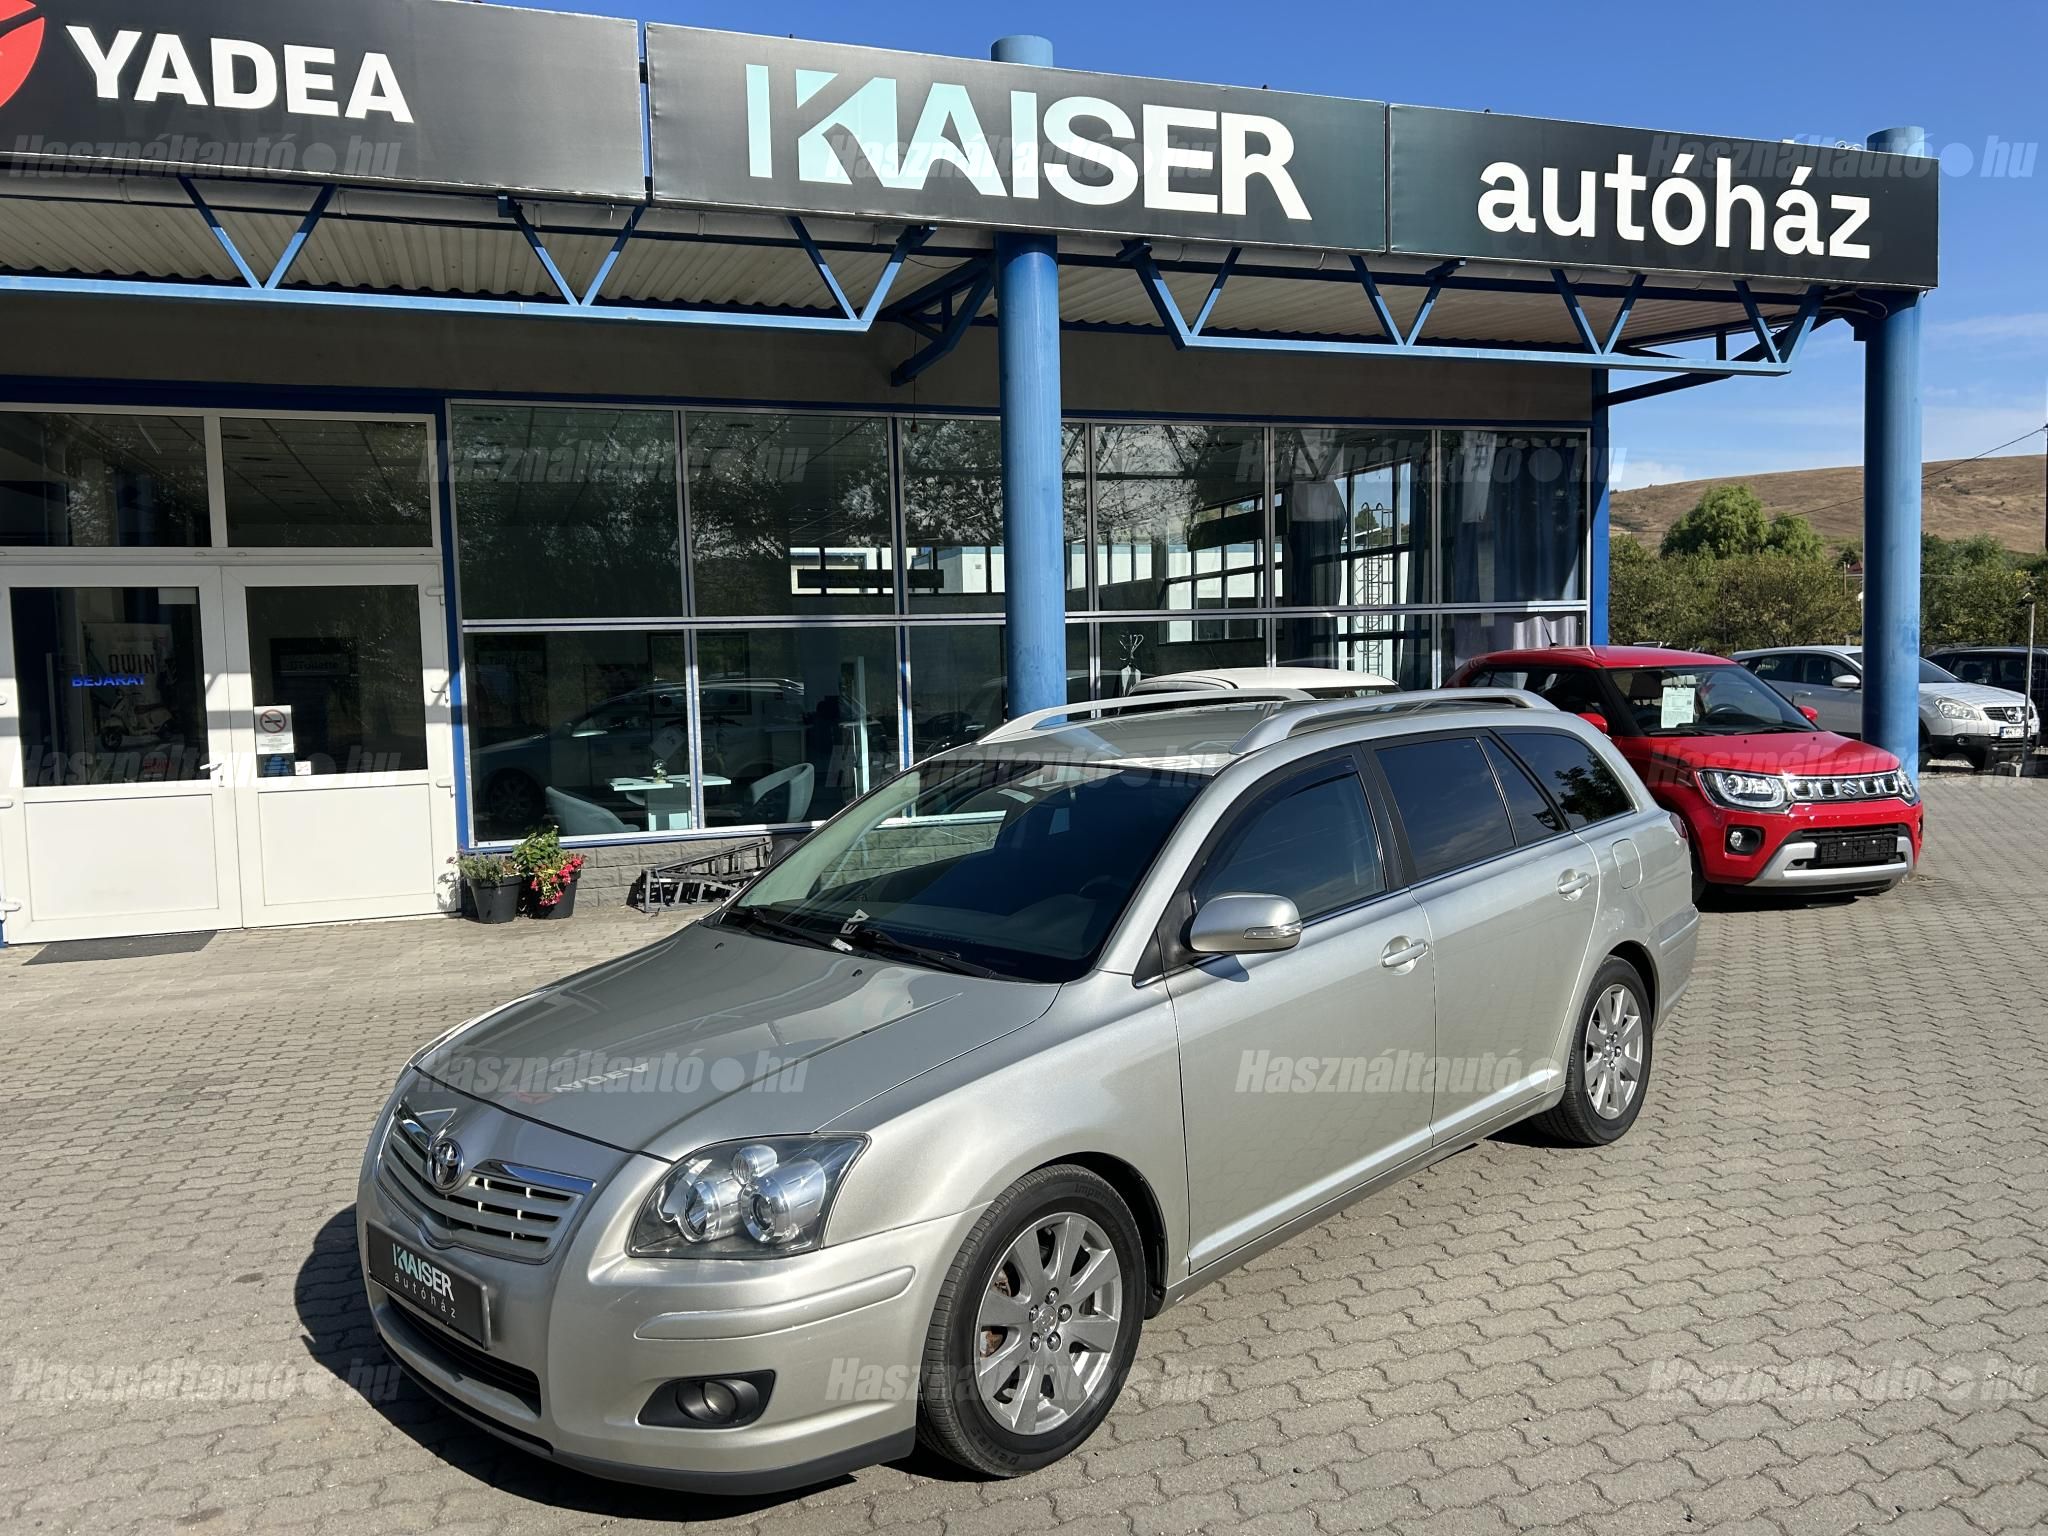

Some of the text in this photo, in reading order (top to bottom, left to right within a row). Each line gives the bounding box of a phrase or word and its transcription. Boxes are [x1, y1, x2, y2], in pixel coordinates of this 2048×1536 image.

[66, 25, 415, 123] YADEA
[745, 64, 1313, 221] KAISER
[1477, 152, 1871, 259] autóház
[393, 1243, 455, 1302] KAISER
[394, 1272, 456, 1318] autóház
